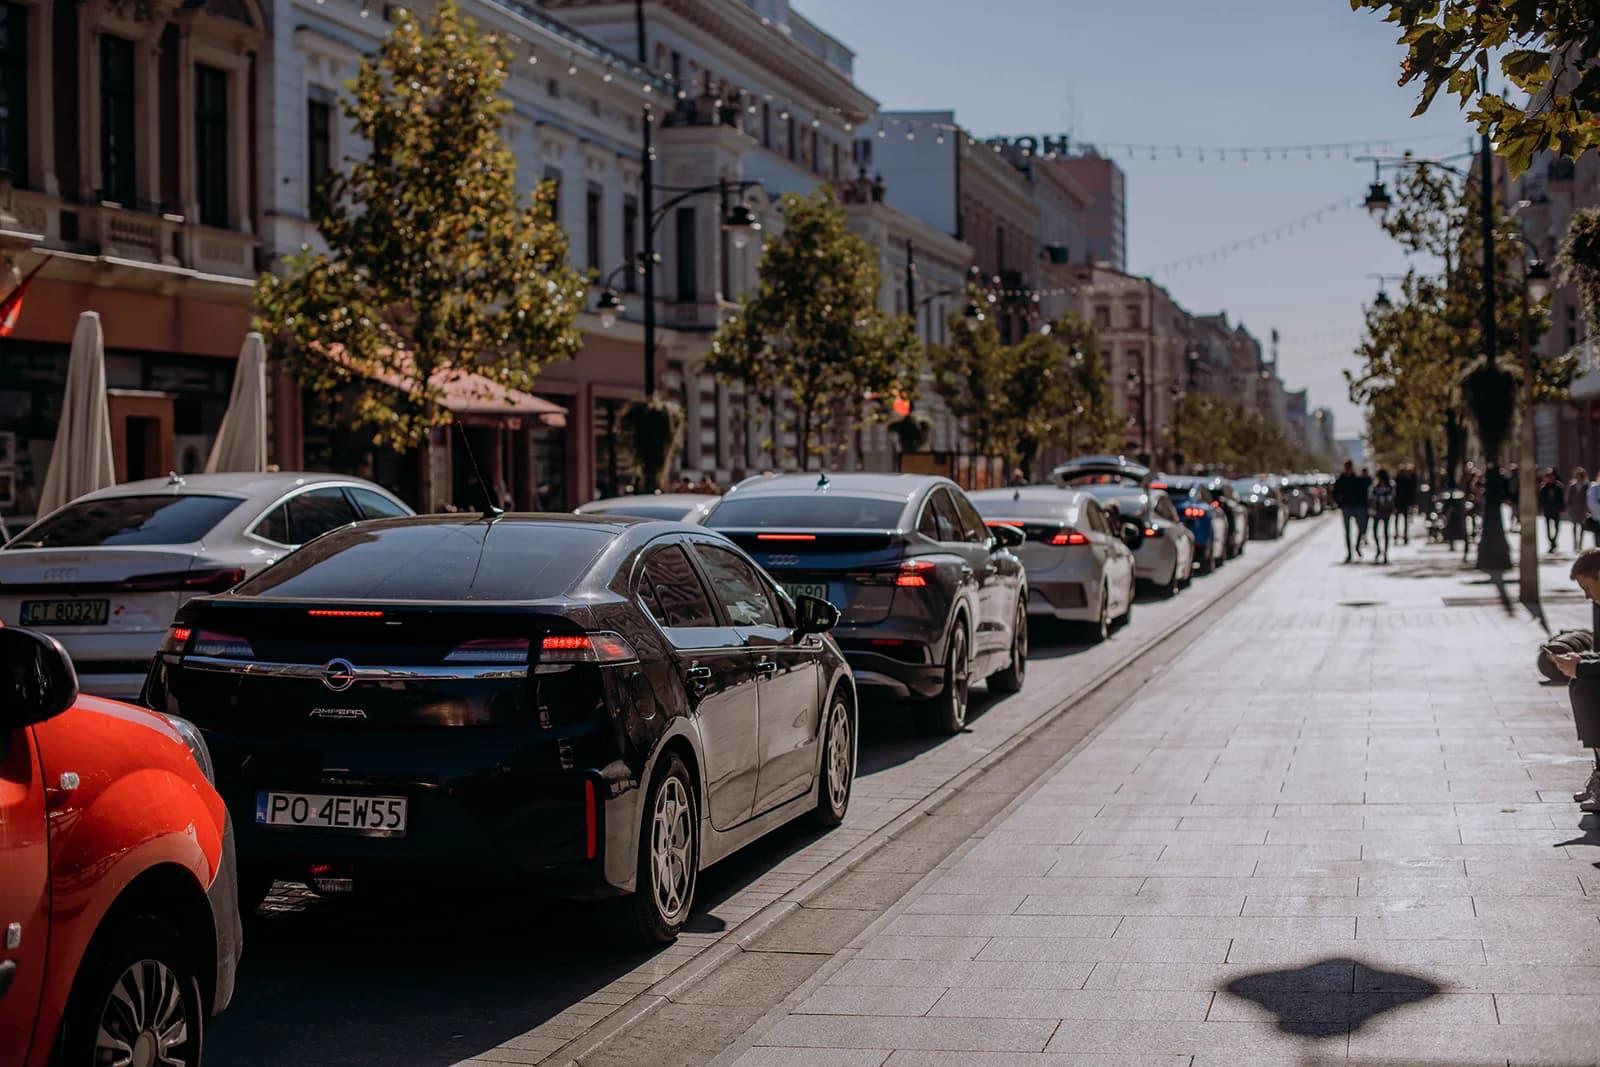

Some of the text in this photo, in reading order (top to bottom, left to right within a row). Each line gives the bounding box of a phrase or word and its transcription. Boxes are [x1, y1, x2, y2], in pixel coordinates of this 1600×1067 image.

[31, 603, 49, 620] CT
[309, 708, 368, 719] AMPERA
[271, 795, 401, 828] PO 4EW55
